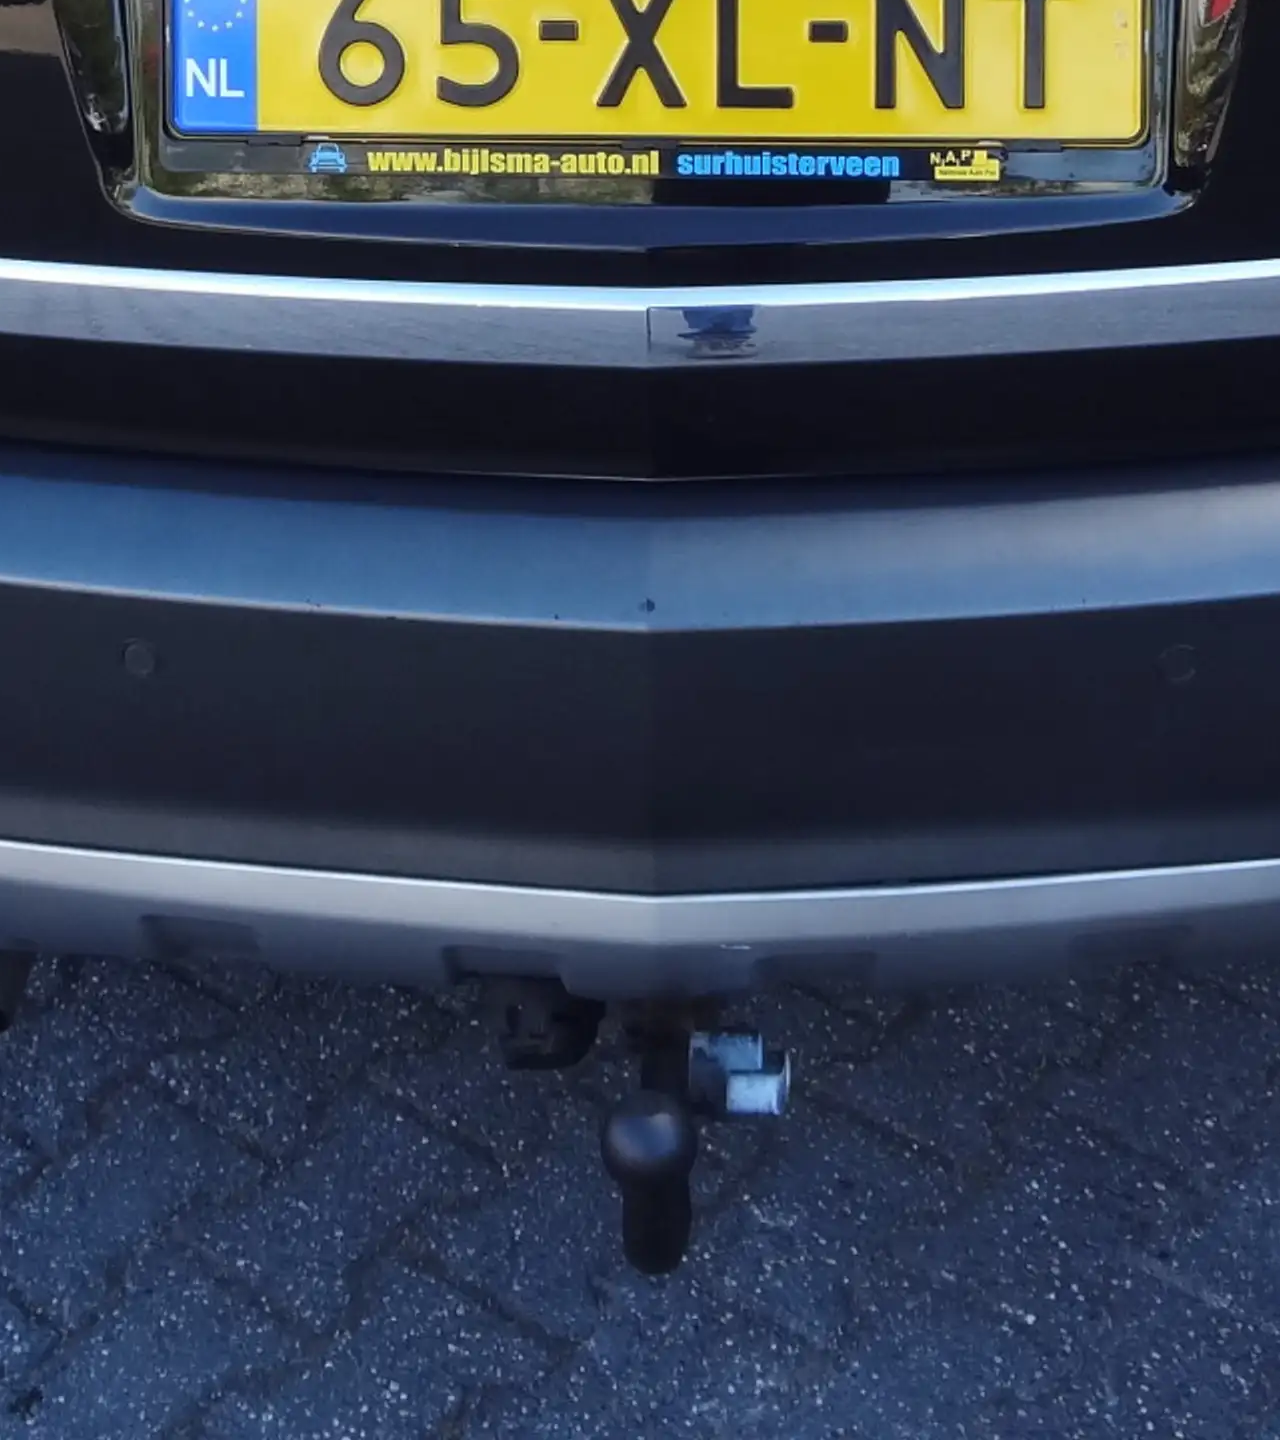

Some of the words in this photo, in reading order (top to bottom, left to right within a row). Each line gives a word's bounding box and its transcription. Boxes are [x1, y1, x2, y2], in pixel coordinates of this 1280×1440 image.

[185, 57, 245, 97] NL
[366, 149, 659, 175] www.bijlsma-auto.nl
[677, 150, 900, 177] surhuisterveen
